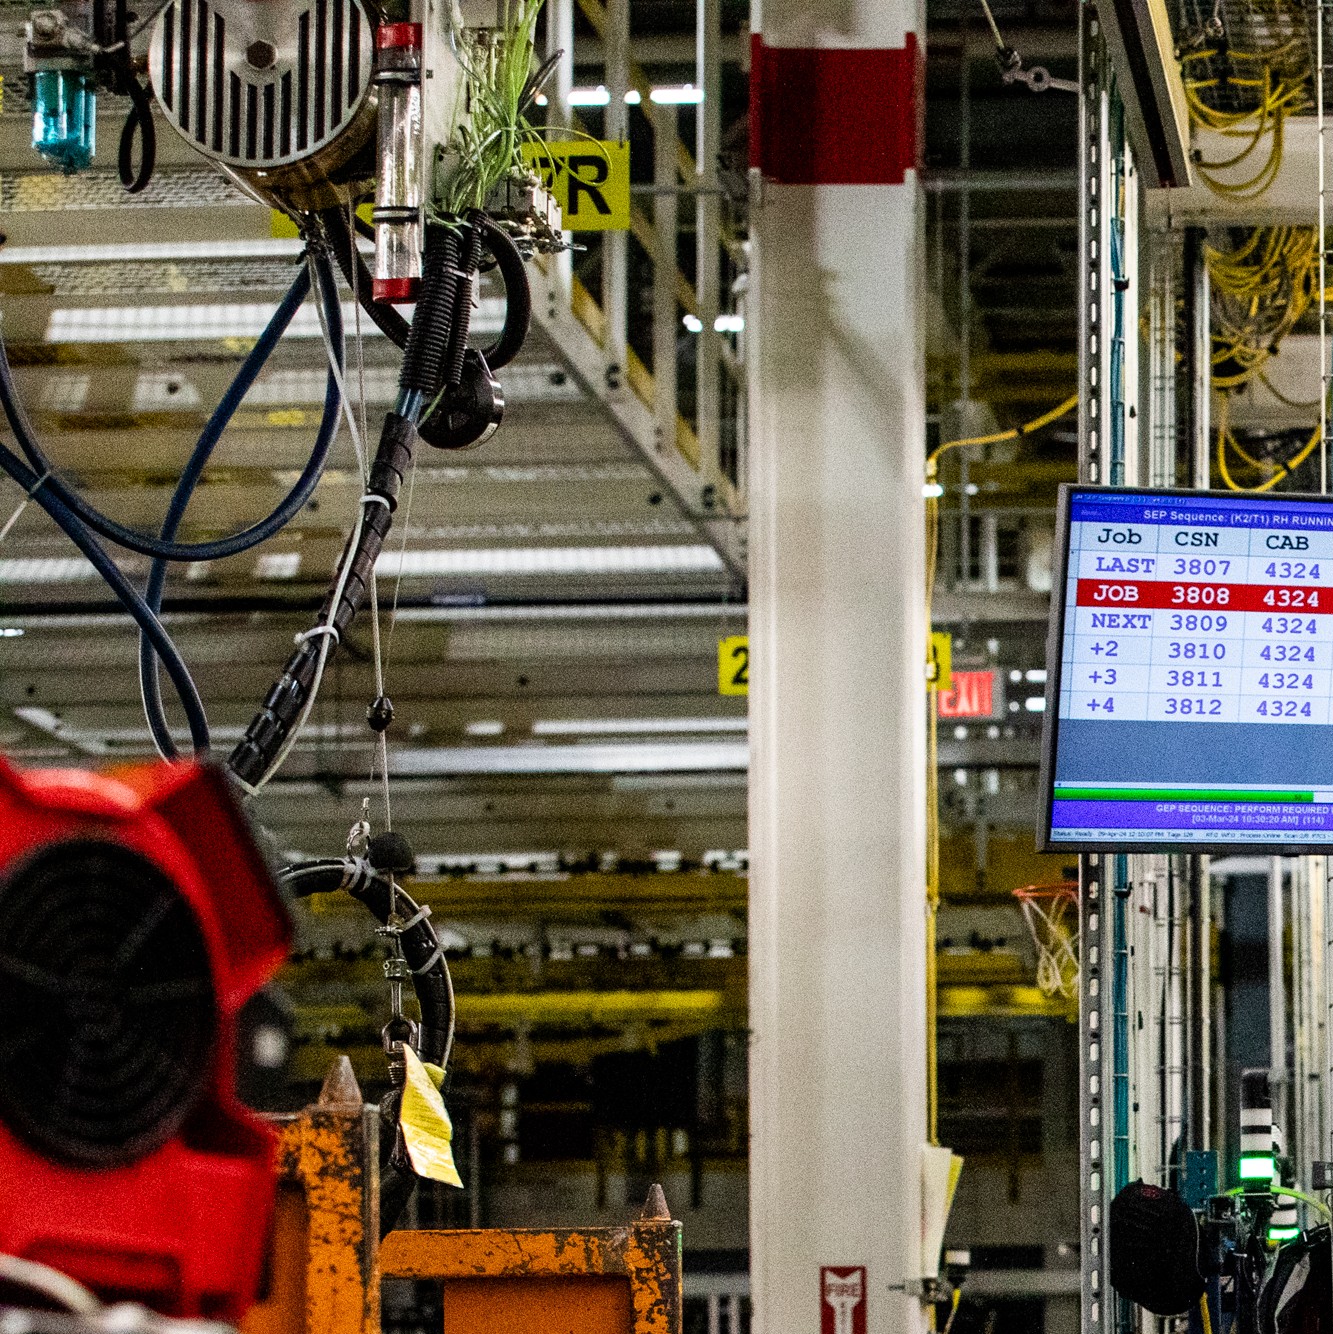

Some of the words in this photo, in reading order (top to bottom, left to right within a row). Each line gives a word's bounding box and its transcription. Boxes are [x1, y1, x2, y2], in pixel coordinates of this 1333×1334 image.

[1144, 510, 1167, 519] SEP
[1170, 511, 1229, 523] Sequence:
[1231, 514, 1269, 525] (K2/T1)
[1273, 516, 1288, 525] RH
[1098, 529, 1142, 545] Job
[1175, 532, 1219, 547] CSN
[1266, 536, 1309, 550] CAB
[1096, 557, 1155, 573] LAST
[1174, 559, 1230, 575] 3807
[1265, 563, 1320, 580] 4324
[1094, 584, 1139, 602] JOB
[1171, 587, 1230, 605] 3808
[1263, 591, 1319, 608] 4324
[1092, 613, 1152, 630] NEXT
[1170, 615, 1227, 632] 3809
[1262, 618, 1317, 635] 4324
[1090, 641, 1118, 657] +2
[1168, 643, 1226, 659] 3810
[1260, 646, 1316, 662] 4324
[1089, 670, 1117, 685] +3
[1166, 671, 1223, 687] 3811
[1258, 673, 1313, 690] 4324
[1087, 698, 1114, 713] +4
[1165, 699, 1222, 715] 3812
[1256, 701, 1311, 717] 4324
[1179, 805, 1233, 813] SEQUENCE:
[1235, 806, 1280, 814] PERFORM
